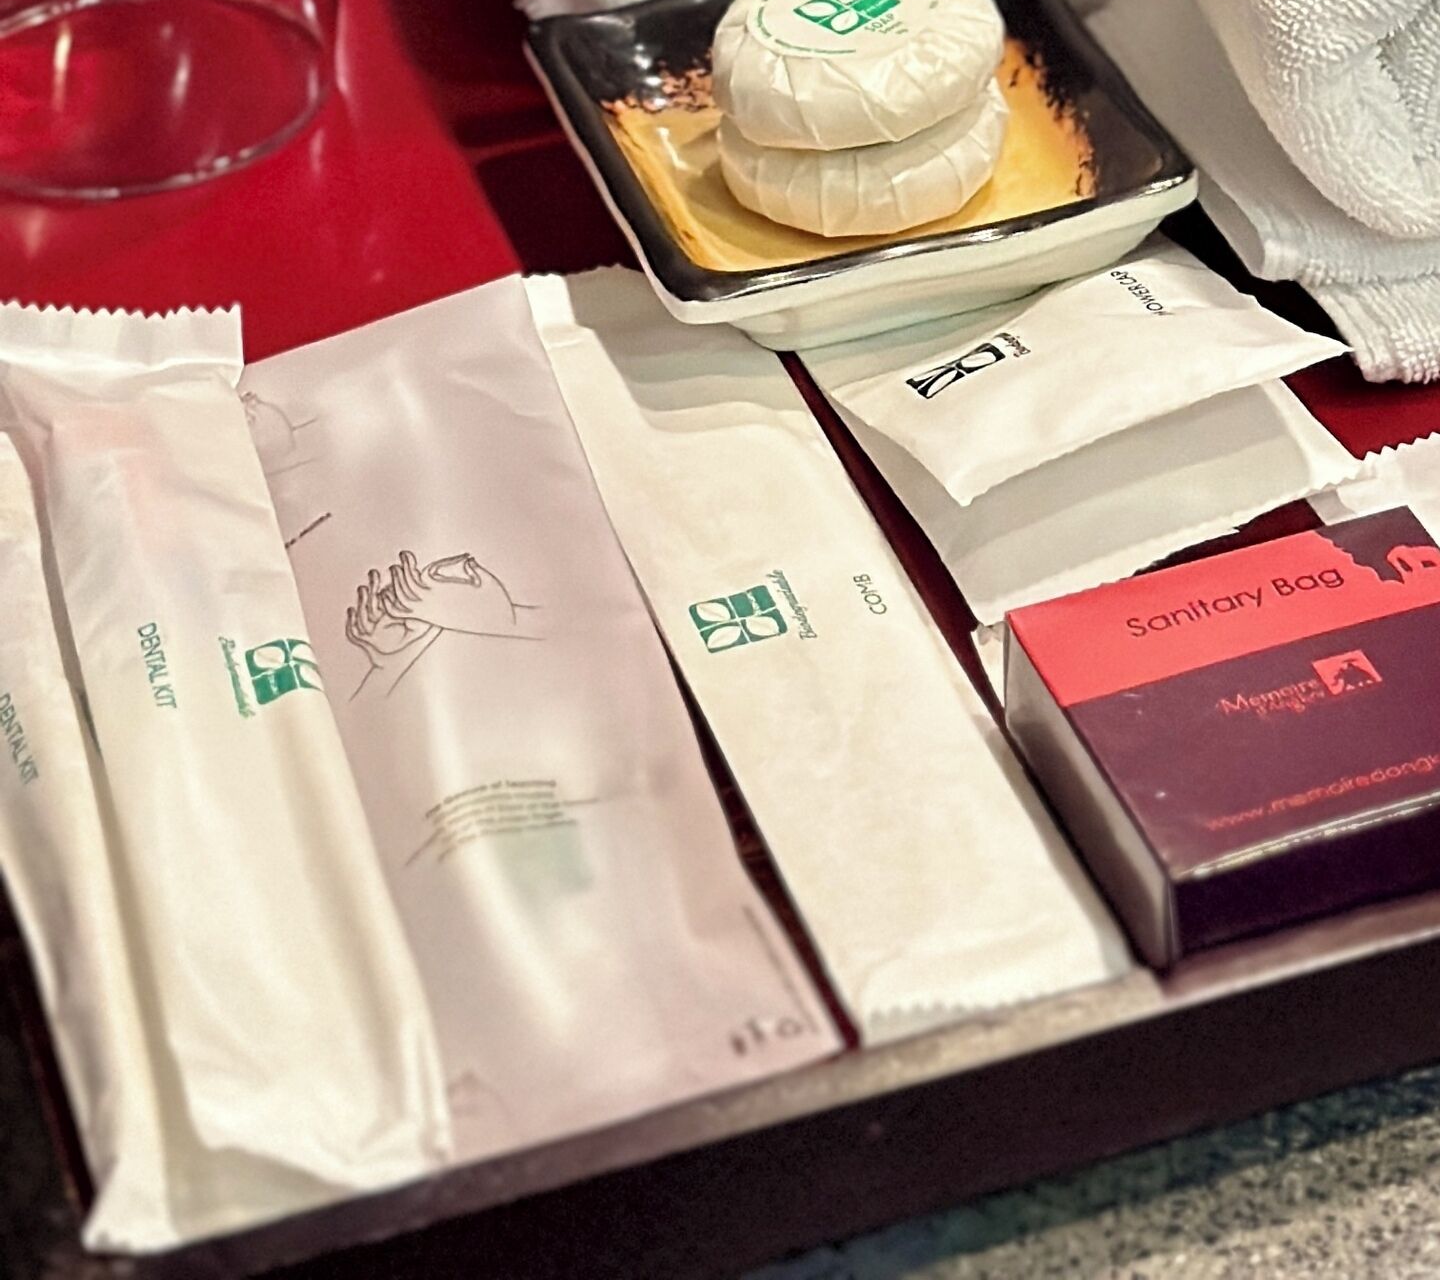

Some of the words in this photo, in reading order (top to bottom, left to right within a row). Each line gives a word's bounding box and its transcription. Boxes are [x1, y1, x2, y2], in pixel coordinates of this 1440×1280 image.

[1110, 271, 1137, 285] CAP
[852, 573, 887, 615] COMB
[1126, 586, 1262, 638] Sanitary
[1271, 568, 1345, 597] Bag
[137, 622, 169, 684] DENTAL
[152, 683, 177, 709] KIT
[18, 754, 39, 785] KIT
